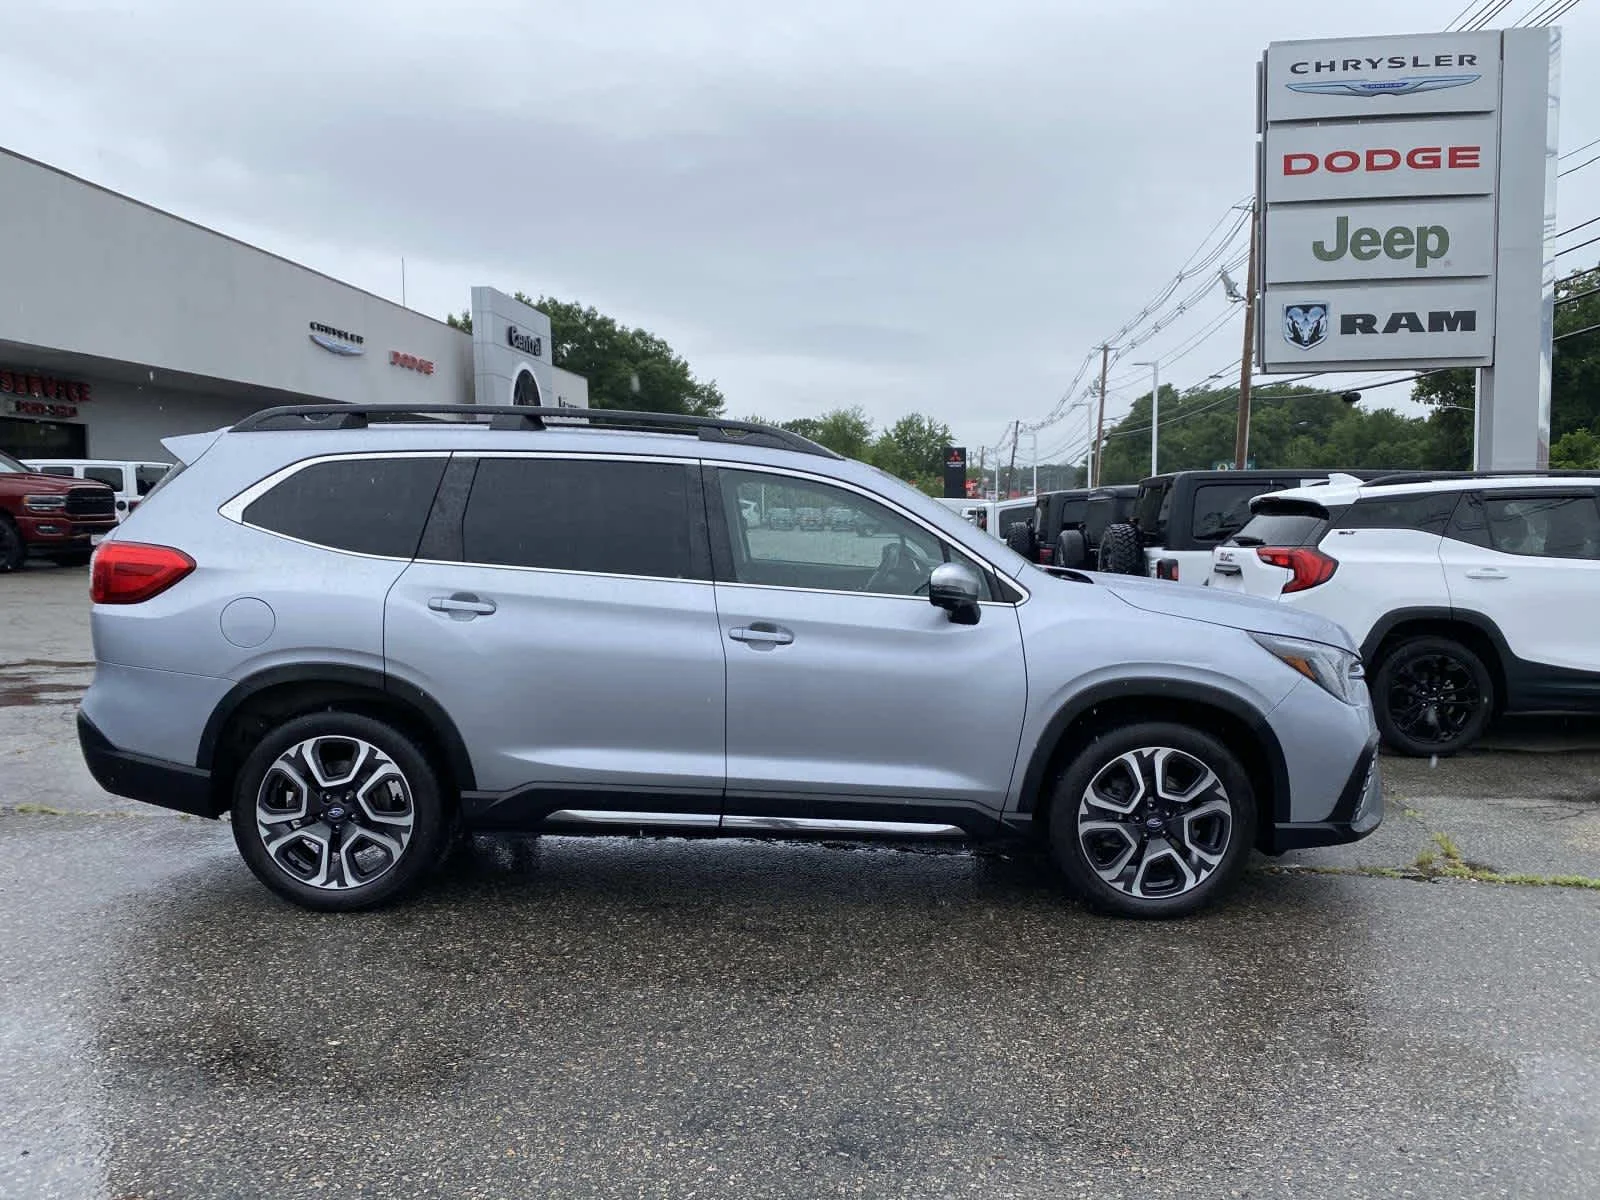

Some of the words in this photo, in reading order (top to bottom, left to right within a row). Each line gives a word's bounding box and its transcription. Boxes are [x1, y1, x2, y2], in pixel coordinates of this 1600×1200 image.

[1290, 54, 1478, 74] CHRYSLER
[1283, 146, 1480, 176] DODGE
[1312, 216, 1450, 268] Jeep
[1340, 310, 1476, 334] RAM
[508, 326, 541, 356] Central
